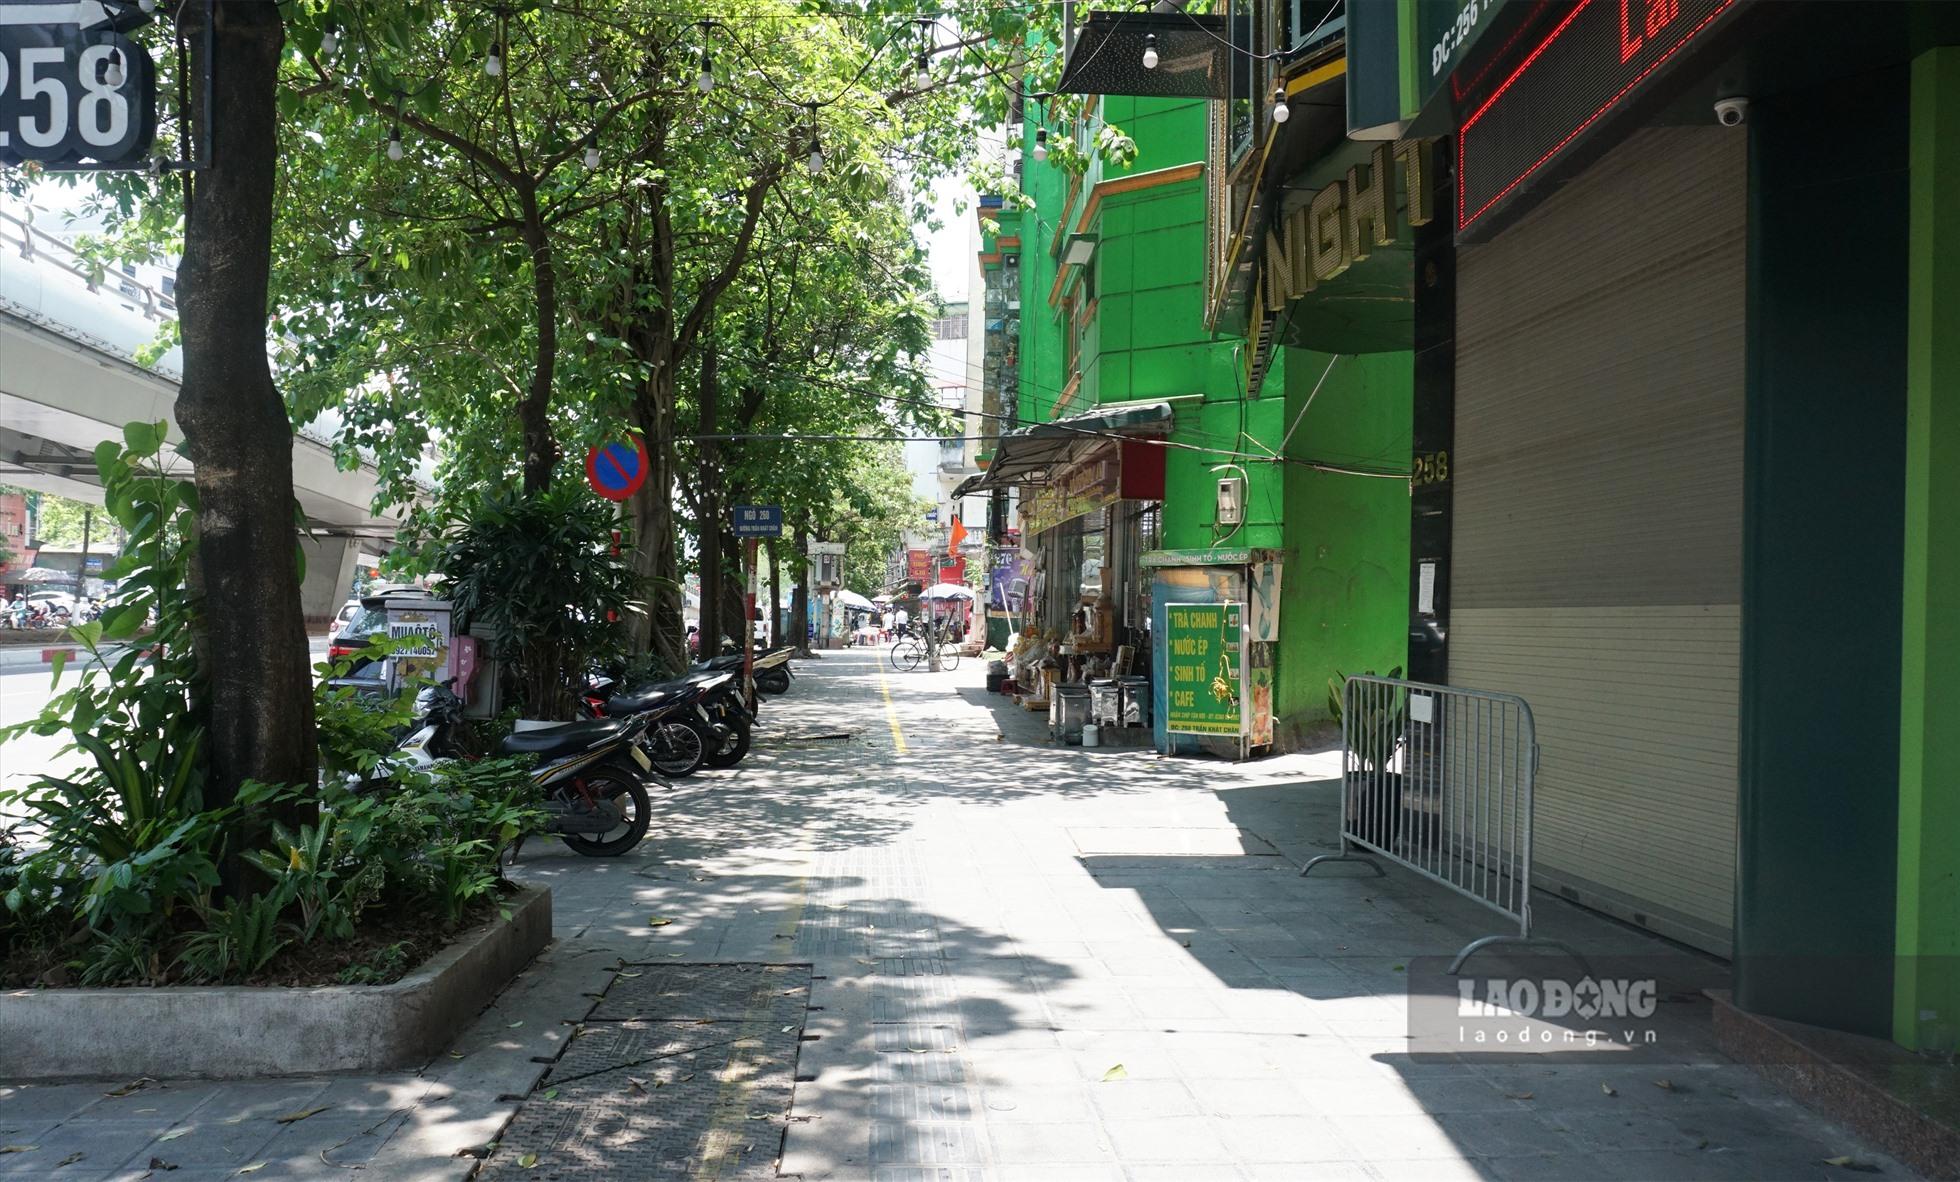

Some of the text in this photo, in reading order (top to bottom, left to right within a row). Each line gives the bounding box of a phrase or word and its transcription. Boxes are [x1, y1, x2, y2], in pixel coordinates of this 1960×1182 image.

[0, 44, 128, 148] 58
[1266, 136, 1434, 312] NIGHT
[1411, 450, 1448, 486] 258
[1173, 609, 1217, 629] TRÀ CHANH
[1174, 635, 1208, 655] NƯỚC ÉP
[1174, 660, 1206, 683] SINH TỐ
[1174, 690, 1195, 707] CAFE
